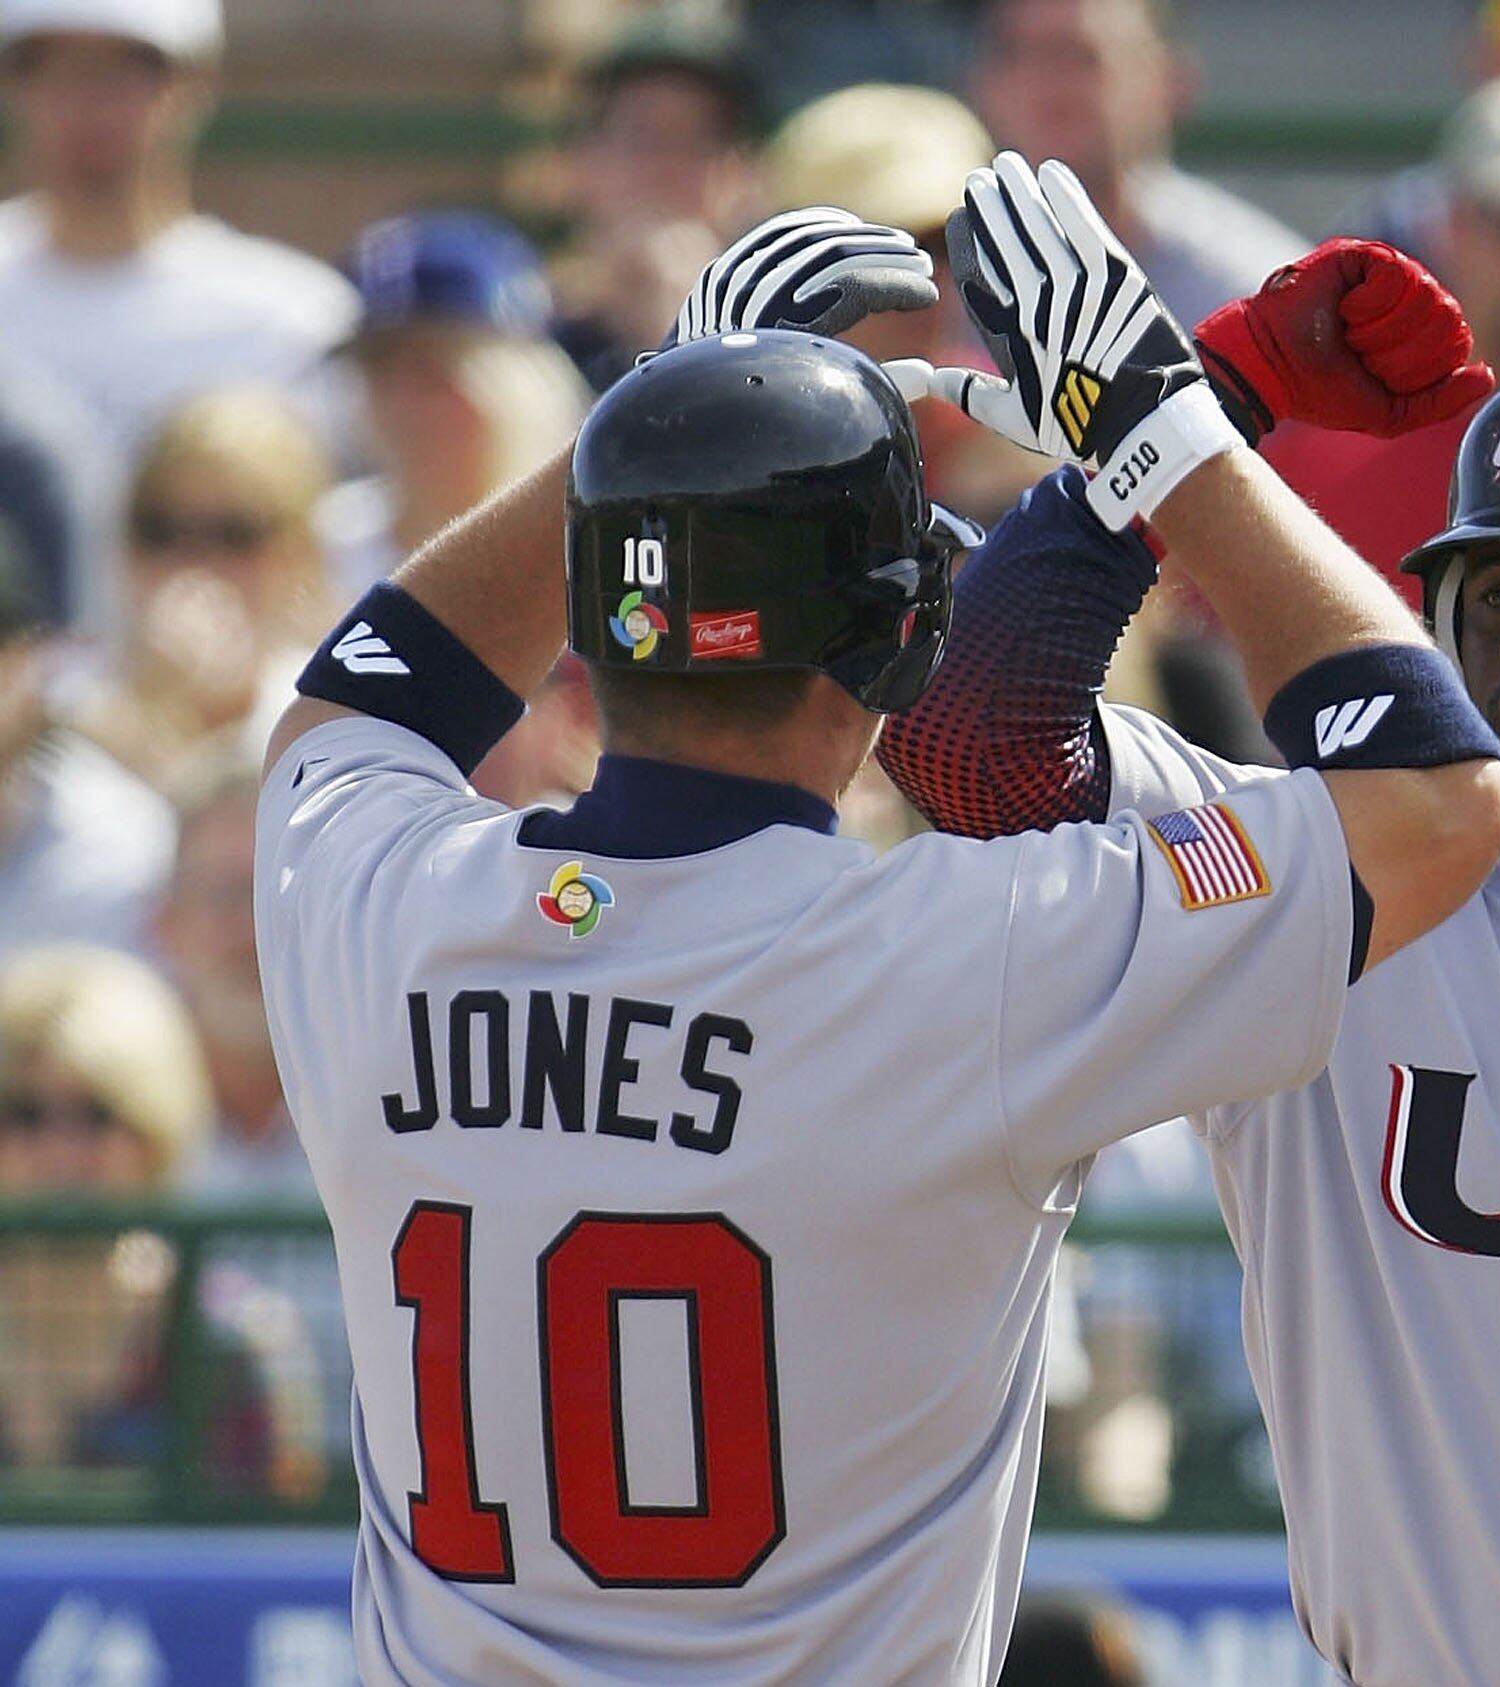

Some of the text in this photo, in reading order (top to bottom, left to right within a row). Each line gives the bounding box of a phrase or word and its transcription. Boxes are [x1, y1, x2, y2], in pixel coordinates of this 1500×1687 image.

[1109, 440, 1161, 501] CJ10
[623, 537, 663, 585] 10
[381, 989, 754, 1156] JONES
[391, 1199, 787, 1589] 10
